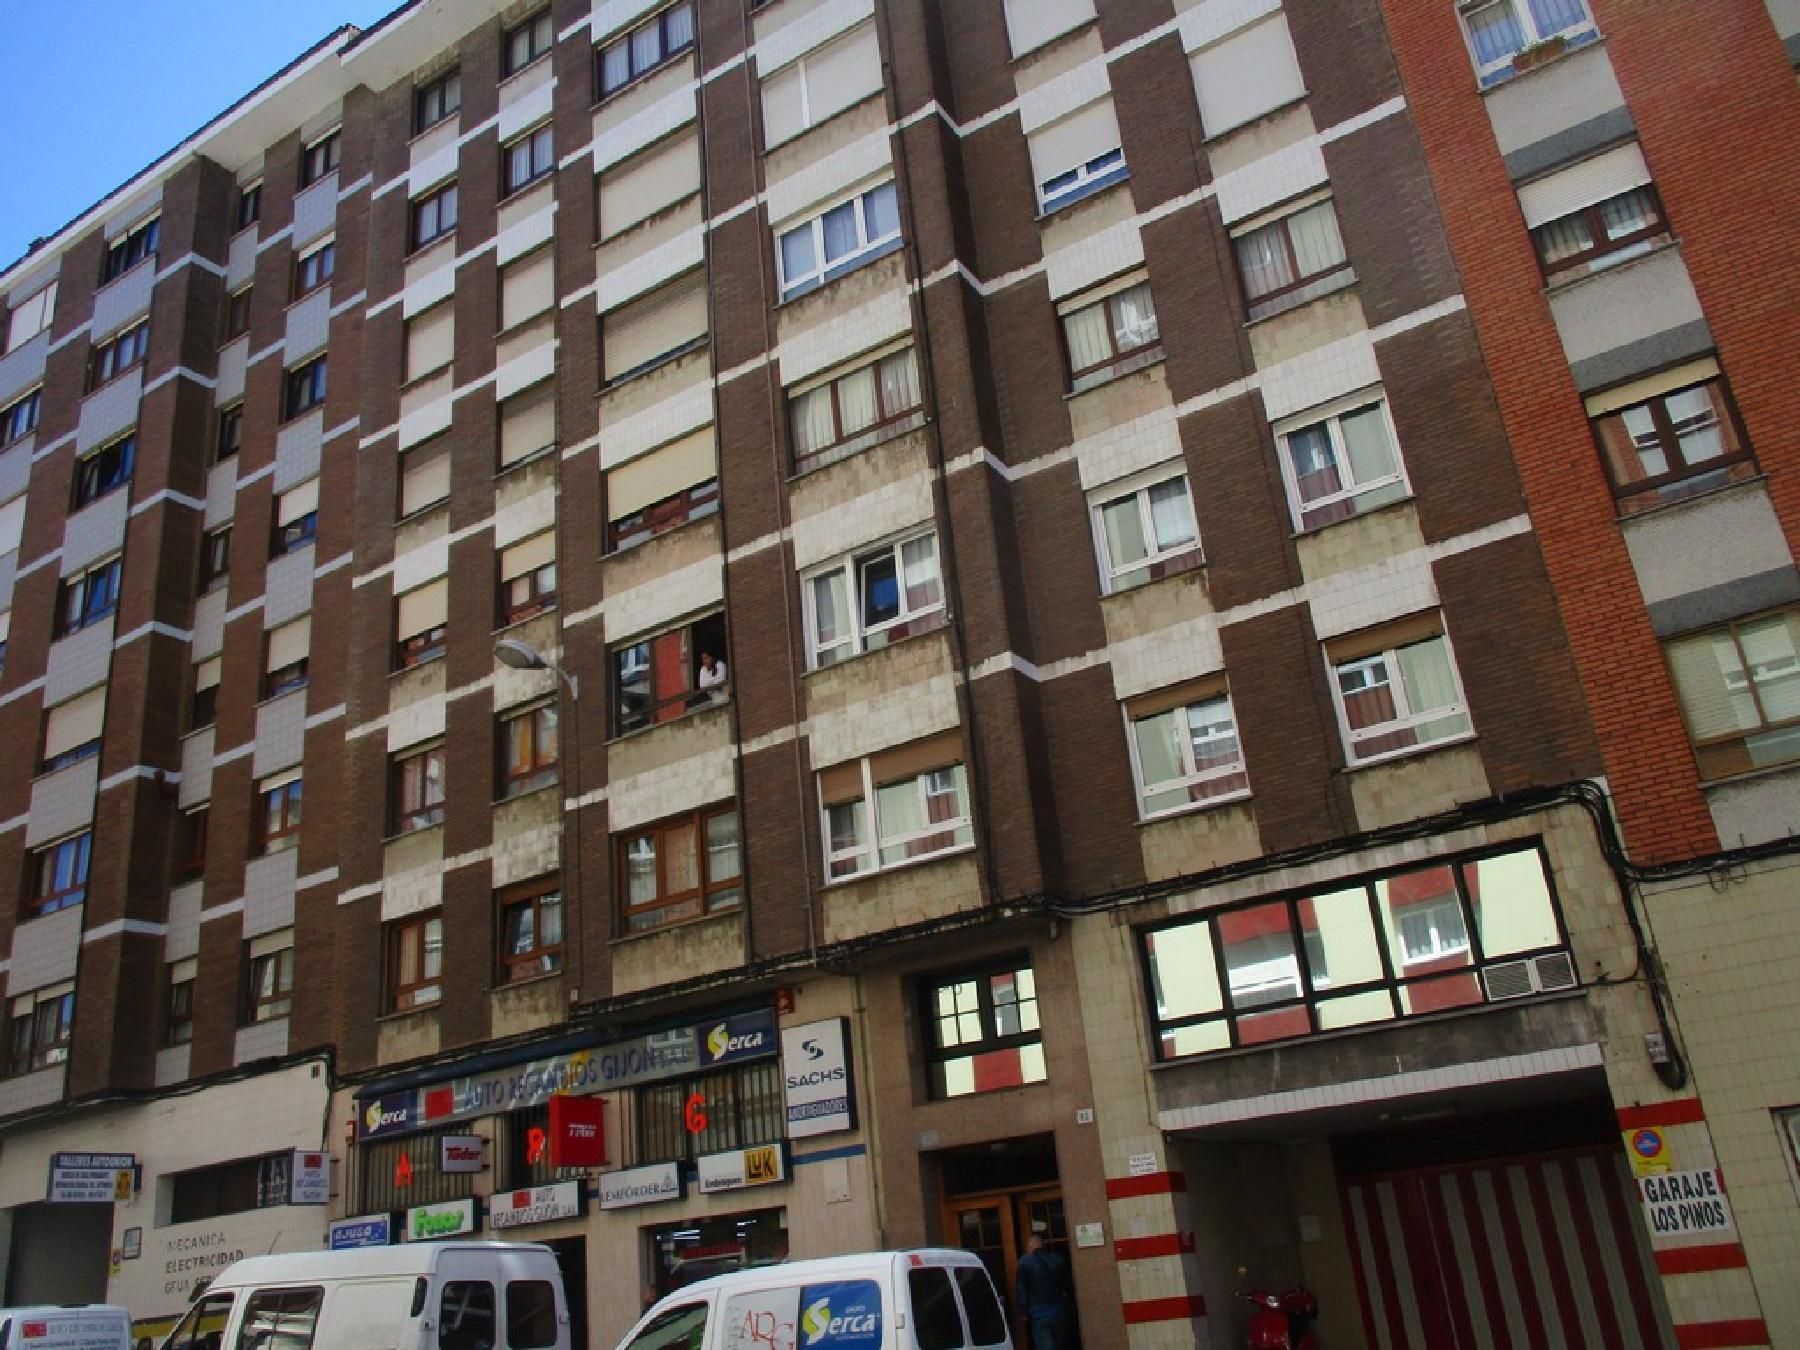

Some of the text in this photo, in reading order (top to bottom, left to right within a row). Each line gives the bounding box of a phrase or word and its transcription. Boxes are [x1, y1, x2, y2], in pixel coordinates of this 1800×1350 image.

[710, 1023, 763, 1061] Serca
[465, 1080, 504, 1109] AUTO
[601, 1047, 656, 1080] GIJON
[787, 1067, 845, 1088] SACHS
[367, 1100, 407, 1133] Serca
[445, 1147, 481, 1161] Tudor
[1645, 1171, 1717, 1203] GARAJE
[1650, 1199, 1725, 1233] LOS PINOS
[168, 1232, 226, 1252] MECANICA
[166, 1250, 244, 1274] ELECTRICIDAD
[805, 1297, 876, 1346] Serca
